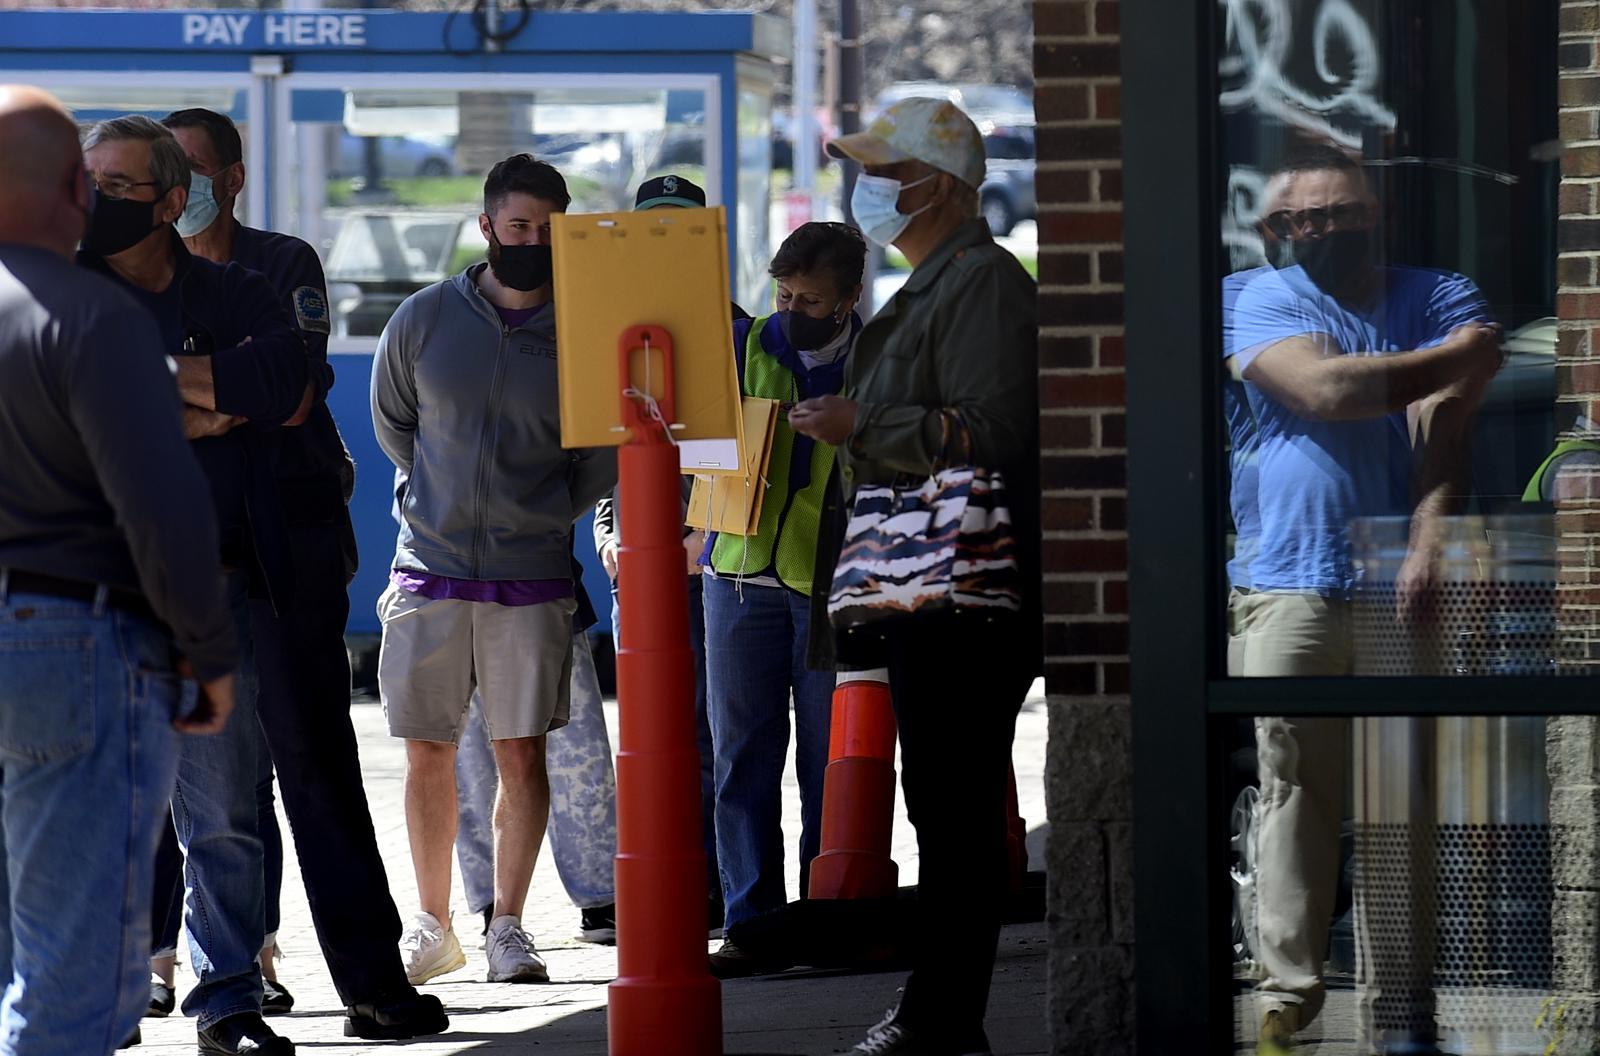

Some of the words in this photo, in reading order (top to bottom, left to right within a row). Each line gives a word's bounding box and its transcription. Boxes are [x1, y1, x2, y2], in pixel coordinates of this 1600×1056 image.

[183, 15, 251, 45] PAY
[264, 15, 367, 46] HERE
[663, 176, 679, 194] S
